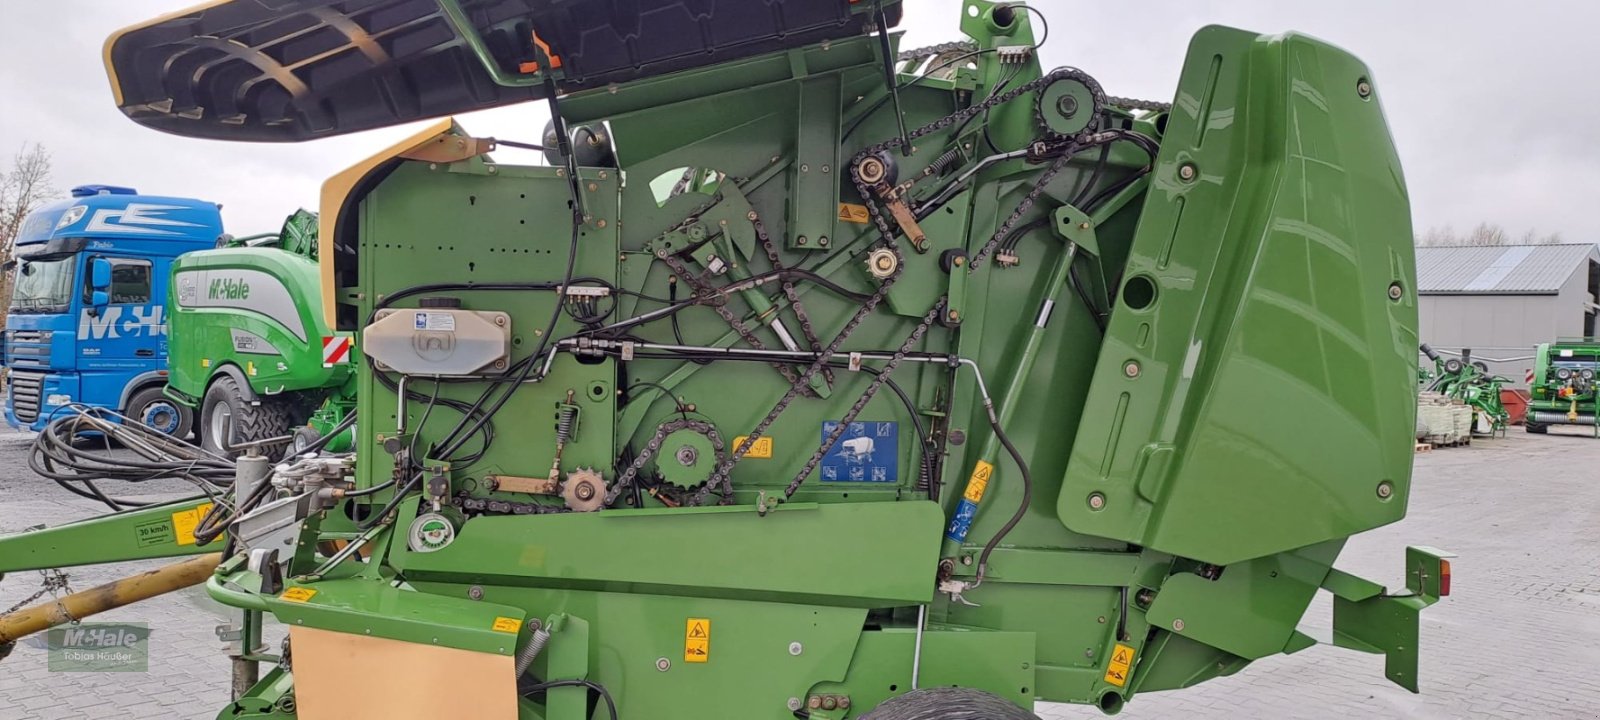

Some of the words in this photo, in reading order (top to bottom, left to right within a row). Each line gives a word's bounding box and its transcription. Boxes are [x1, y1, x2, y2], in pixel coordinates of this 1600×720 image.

[208, 278, 250, 300] McHale
[77, 305, 168, 340] McH
[139, 528, 149, 536] 30
[150, 525, 169, 533] km/h
